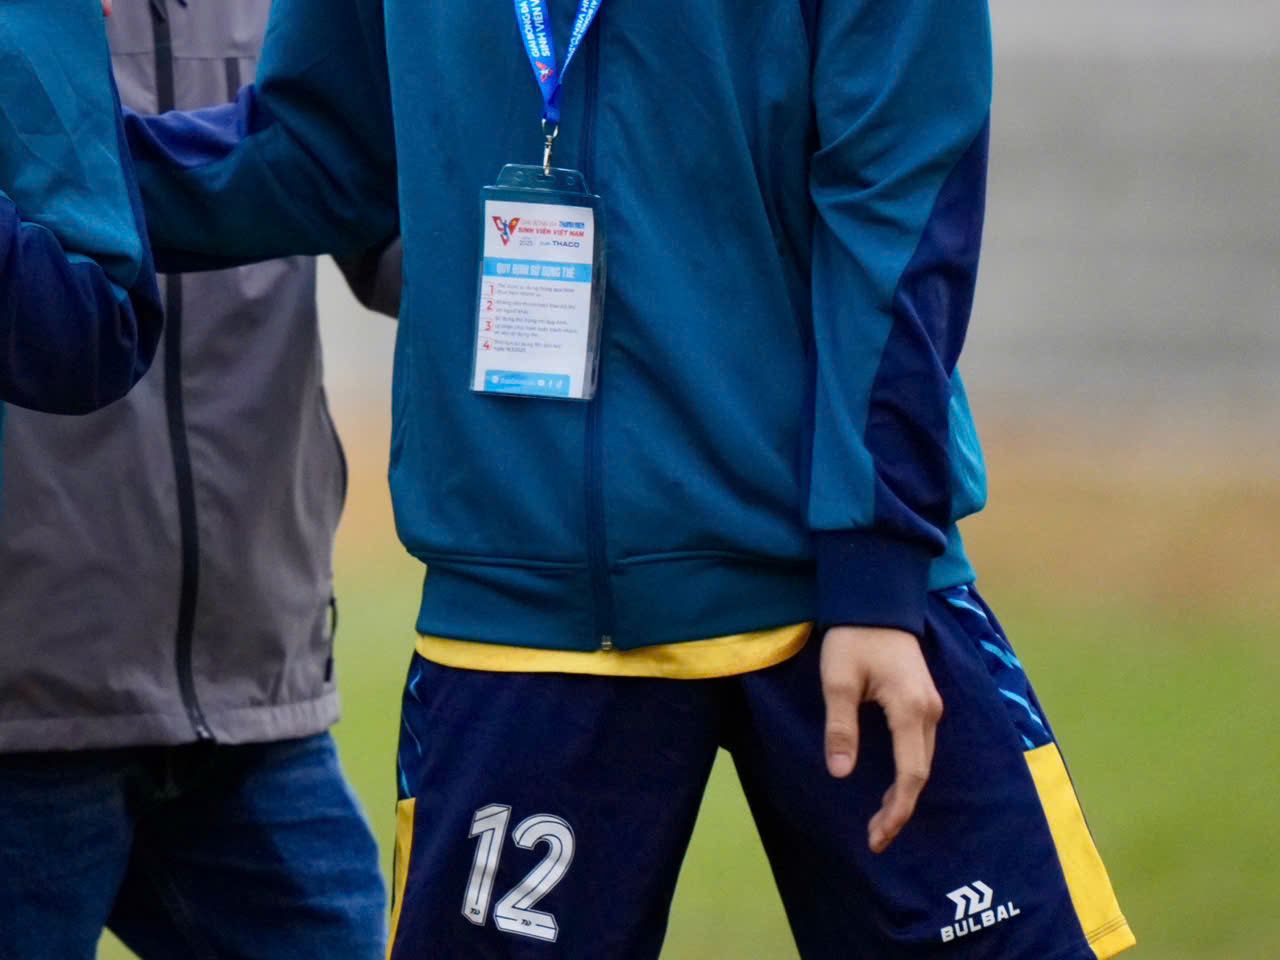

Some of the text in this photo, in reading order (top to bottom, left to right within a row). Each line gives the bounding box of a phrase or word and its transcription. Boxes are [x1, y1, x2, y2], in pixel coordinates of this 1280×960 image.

[536, 32, 551, 56] SINH
[569, 230, 585, 238] NAM
[552, 240, 580, 248] THACO
[487, 300, 494, 311] 2
[485, 320, 492, 333] 3
[483, 340, 491, 351] 4
[461, 802, 576, 943] 12
[940, 901, 1021, 943] BULBAL
